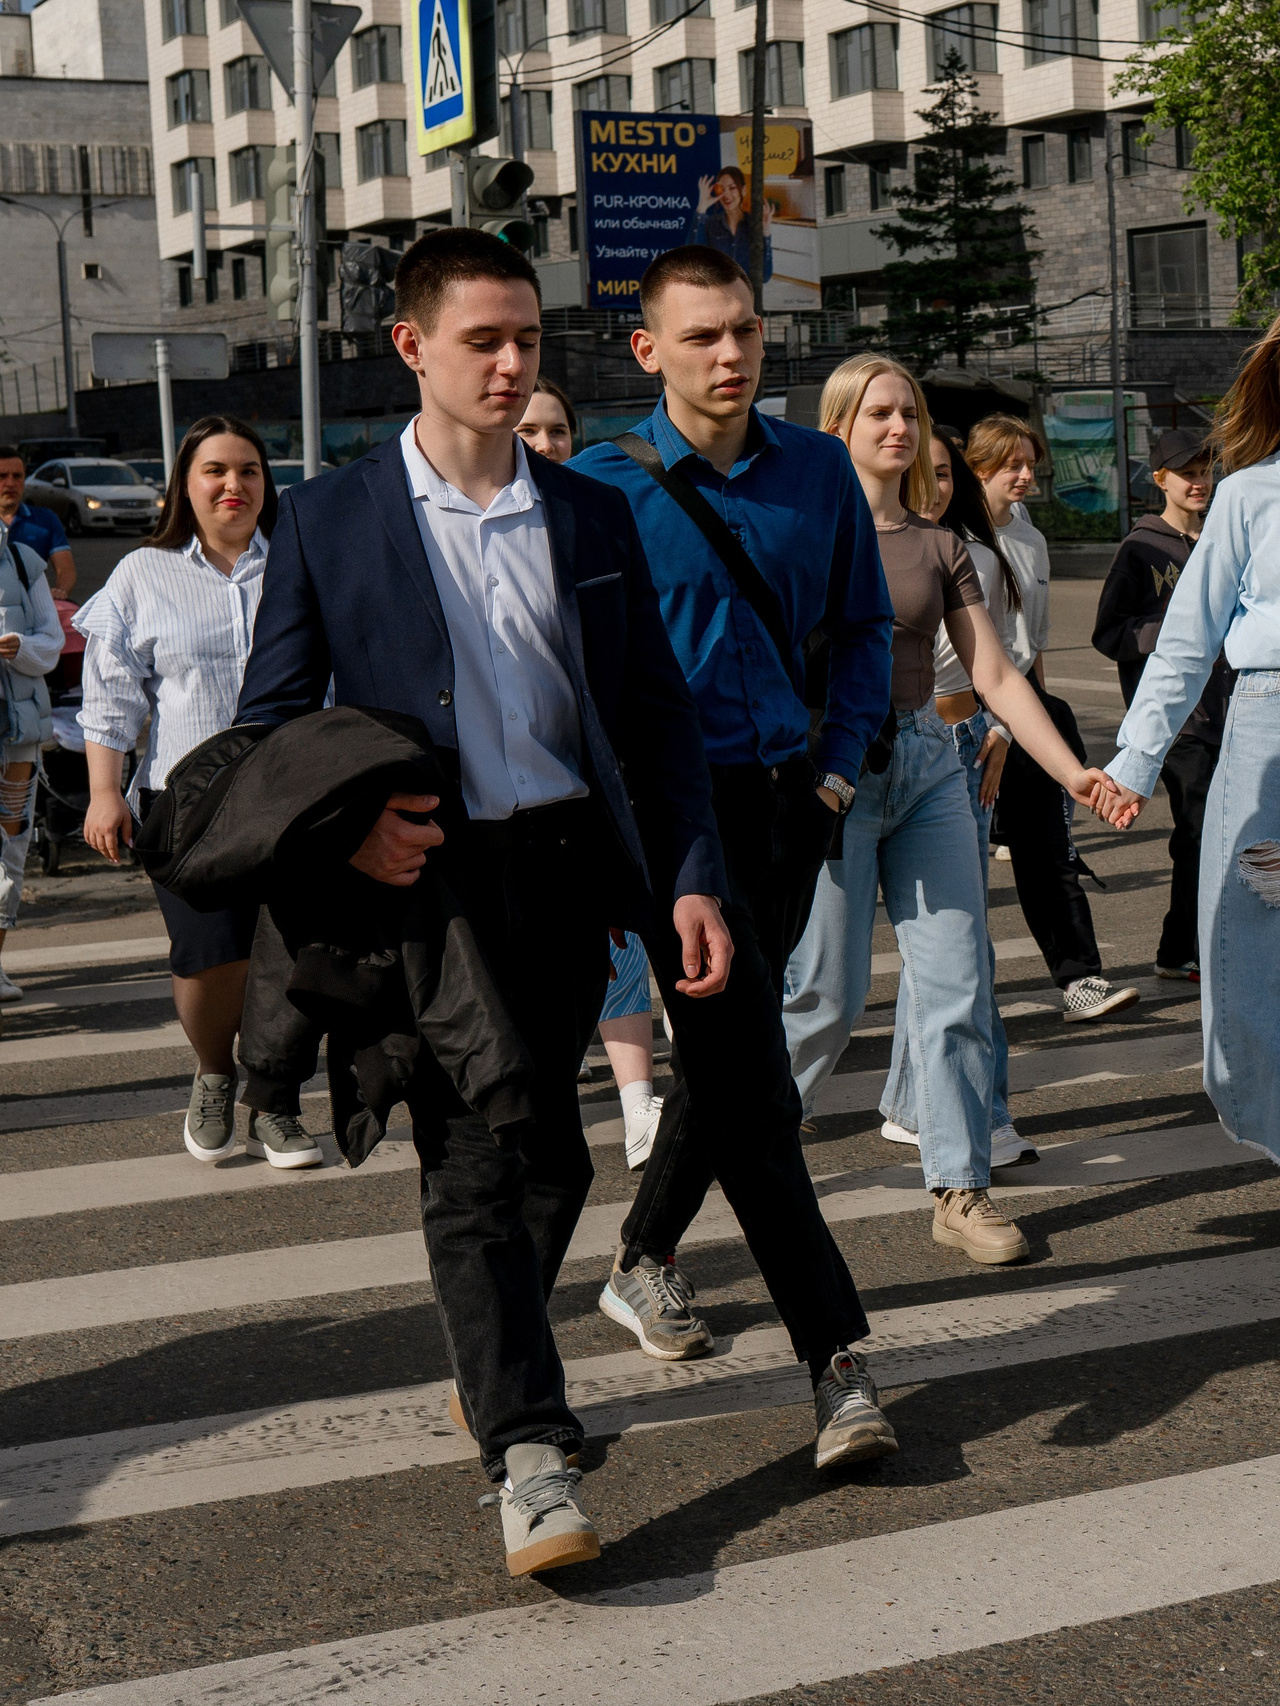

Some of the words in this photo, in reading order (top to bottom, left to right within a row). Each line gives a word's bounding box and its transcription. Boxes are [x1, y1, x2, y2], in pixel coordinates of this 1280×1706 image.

[592, 152, 677, 174] КУХНИ
[594, 195, 691, 210] PUR-КРОМКА
[595, 219, 619, 229] или
[622, 217, 685, 230] обычная?
[596, 245, 649, 258] Узнайте
[649, 248, 659, 262] у
[597, 280, 640, 296] МИР
